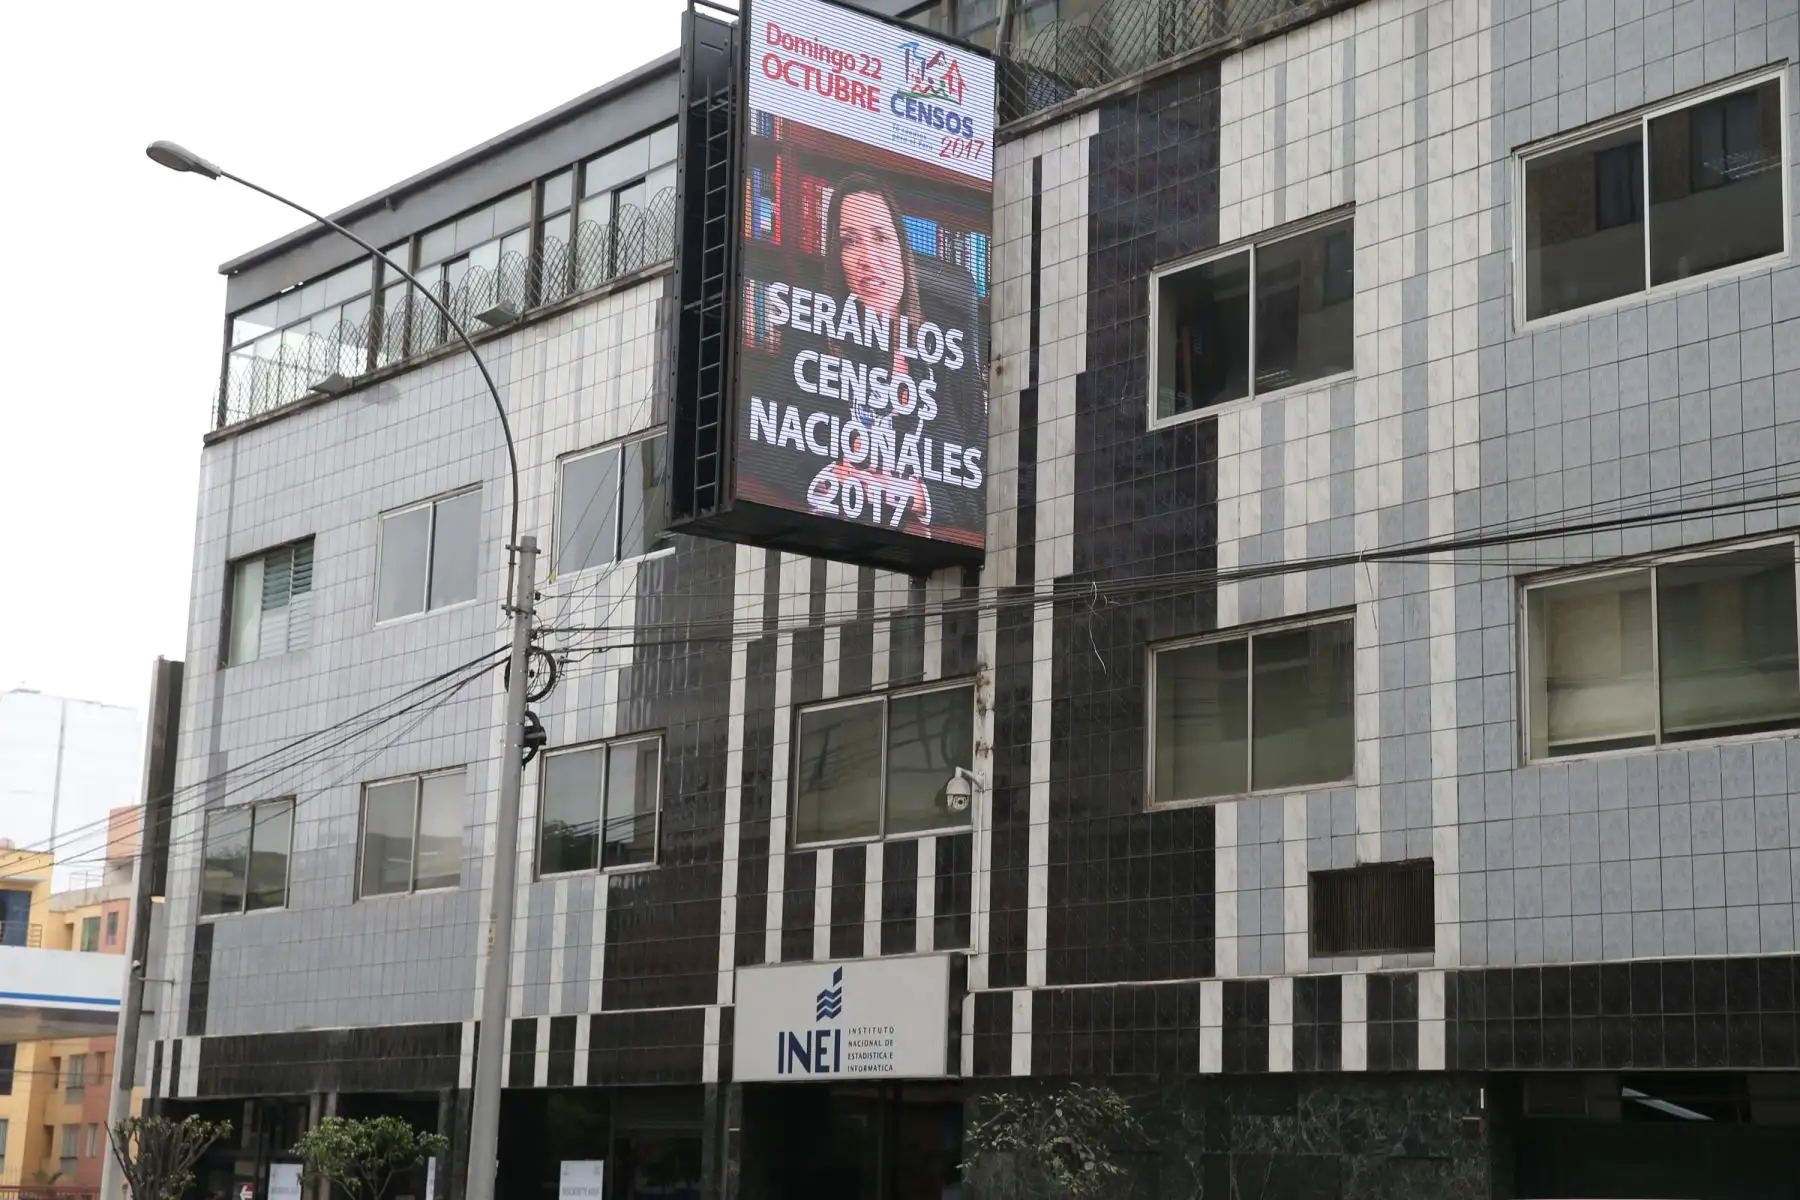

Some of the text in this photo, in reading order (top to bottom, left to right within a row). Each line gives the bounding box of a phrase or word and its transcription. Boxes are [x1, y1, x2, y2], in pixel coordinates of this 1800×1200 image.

[766, 22, 882, 81] Domingo 22
[762, 53, 881, 113] OCTUBRE
[890, 94, 974, 139] CENSOS
[939, 135, 985, 160] 2017
[767, 281, 965, 371] SERÁN LOS
[793, 349, 938, 421] CENSOS
[750, 396, 983, 489] NACIONALES
[810, 469, 911, 528] 2017
[778, 1028, 841, 1074] INEI
[848, 1026, 895, 1035] INSTITUTO
[848, 1039, 893, 1047] NACIONAL DE
